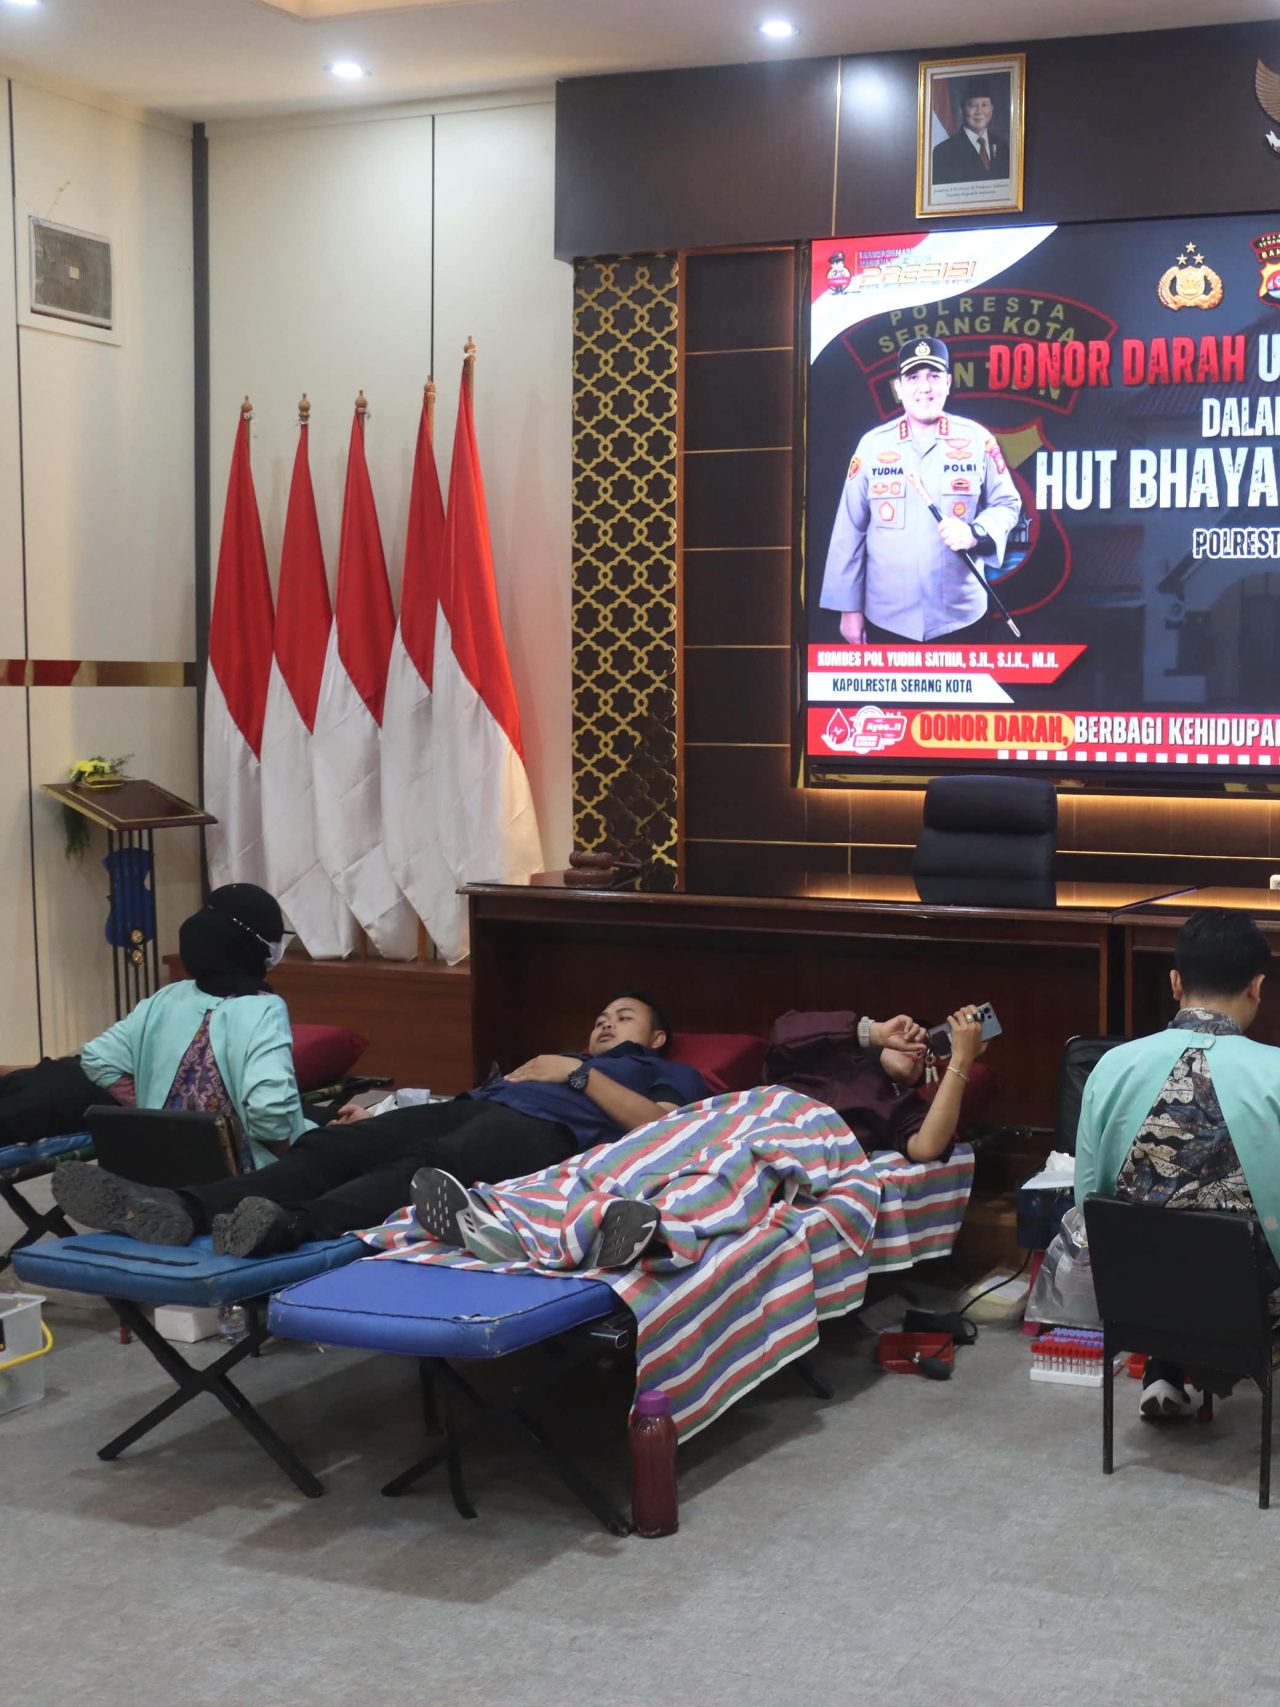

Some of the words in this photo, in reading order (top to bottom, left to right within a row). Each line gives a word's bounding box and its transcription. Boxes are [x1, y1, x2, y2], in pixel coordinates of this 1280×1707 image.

[890, 297, 1065, 327] POLRESTA
[878, 315, 992, 353] SERANG
[1003, 316, 1076, 344] KOTA
[988, 339, 1112, 391] DONOR
[1121, 333, 1247, 388] DARAH
[871, 467, 904, 476] YUDHA
[943, 463, 977, 473] POLRI
[1035, 449, 1118, 511] HUT
[817, 651, 862, 667] KOMBES
[886, 651, 922, 667] YUDHA
[832, 677, 898, 693] KAPOLRESTA
[900, 678, 942, 693] SERANG
[945, 679, 973, 693] KOTA
[919, 713, 988, 742] DONOR
[993, 714, 1070, 746] DARAH,
[1073, 715, 1164, 746] BERBAGI
